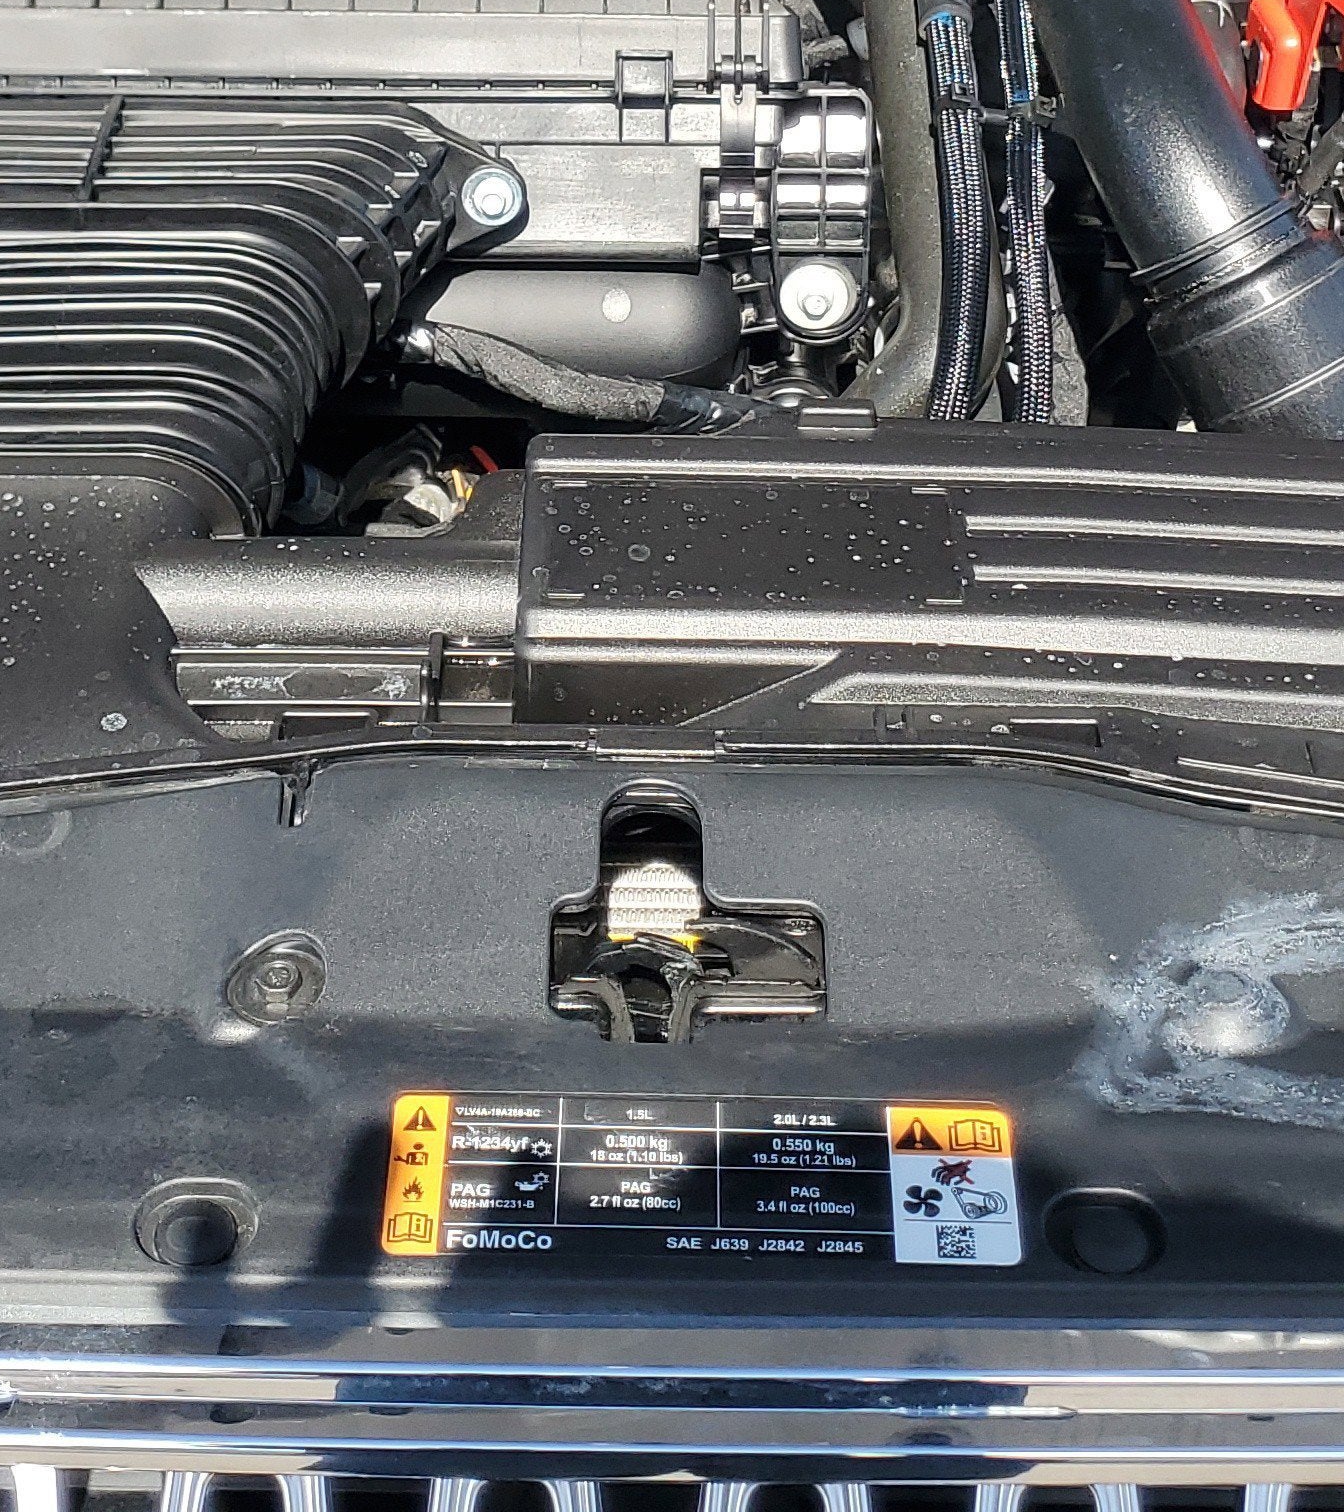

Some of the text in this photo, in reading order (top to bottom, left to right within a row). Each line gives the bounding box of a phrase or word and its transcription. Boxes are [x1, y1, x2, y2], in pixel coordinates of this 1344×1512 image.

[626, 1108, 654, 1120] 1.5L
[773, 1113, 800, 1125] 2.0L
[808, 1115, 836, 1126] 2.3L
[451, 1135, 530, 1153] R-1234yf
[606, 1134, 668, 1151] 0.500 kg
[772, 1138, 835, 1155] 0.550 kg
[590, 1149, 683, 1165] 18 oz (1.10 lbs)
[752, 1153, 856, 1168] 19.5 oz (1.21 lbs)
[450, 1182, 491, 1197] PAG
[621, 1181, 653, 1194] PAG
[790, 1186, 820, 1198] PAG
[448, 1198, 535, 1209] WSH-M1C231-B
[590, 1195, 681, 1212] 2.7 fl oz (80cc)
[756, 1200, 855, 1217] 3.4 fl oz (100cc)
[446, 1229, 552, 1250] FoMoCo
[666, 1236, 864, 1254] SAE J639 J2842 J2845
